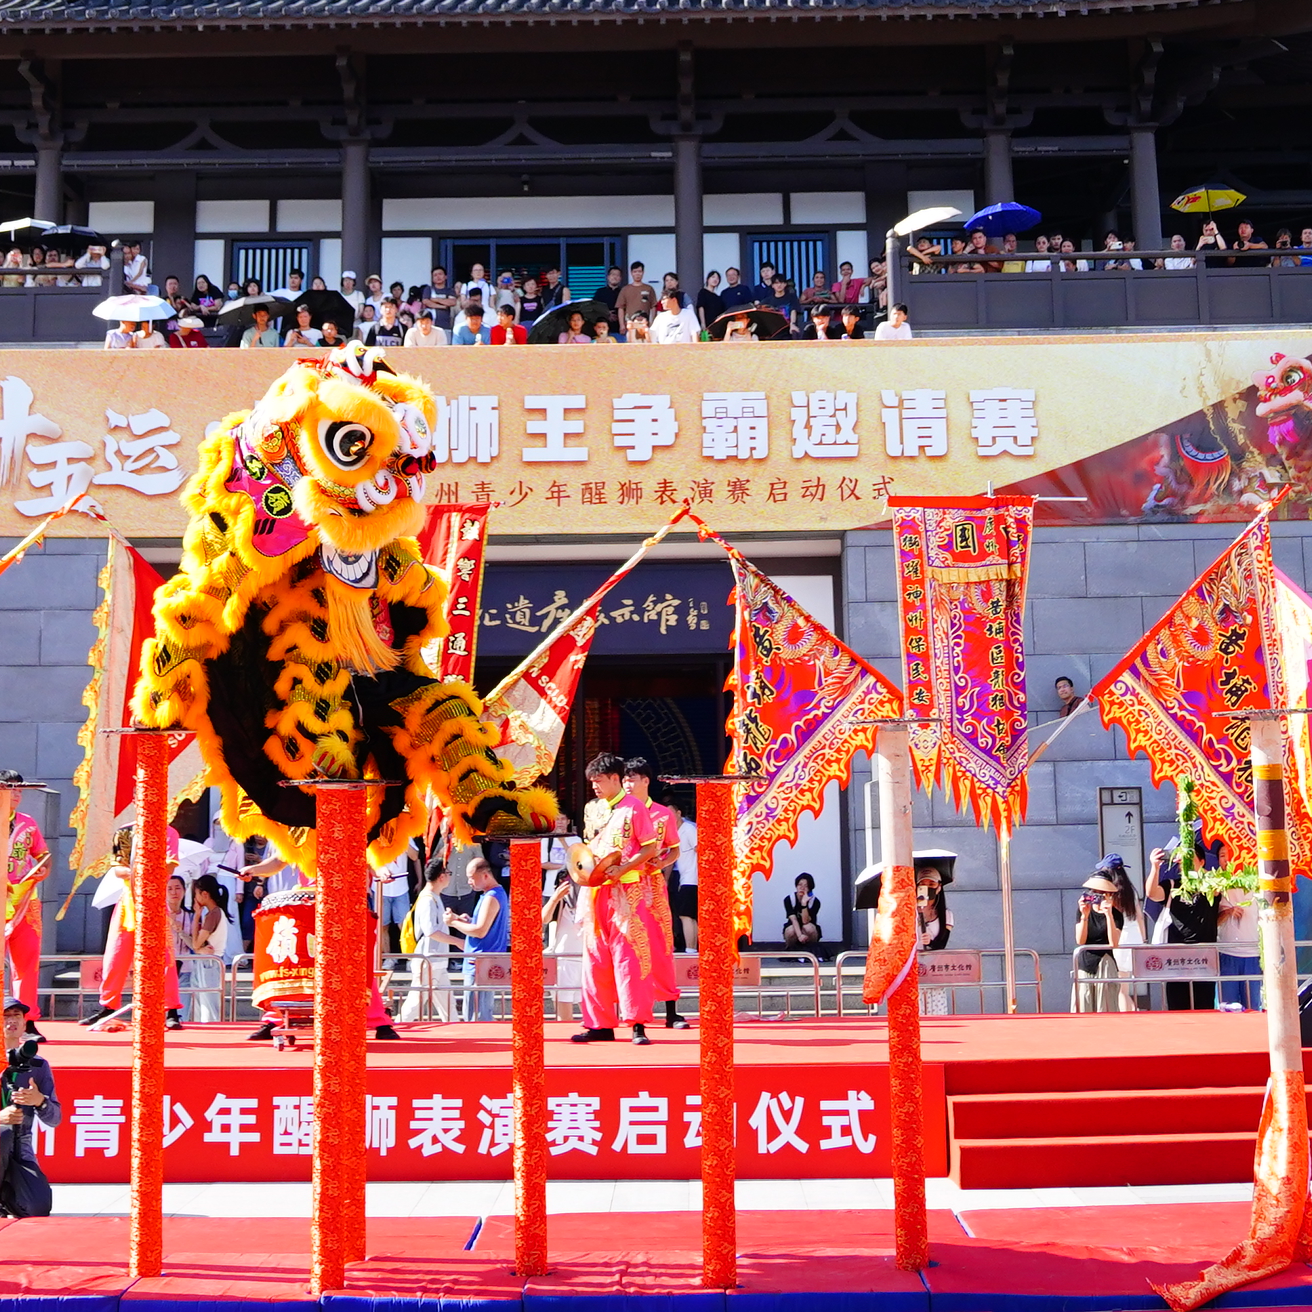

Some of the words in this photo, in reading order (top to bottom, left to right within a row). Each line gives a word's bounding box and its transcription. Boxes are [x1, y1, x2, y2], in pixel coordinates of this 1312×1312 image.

[434, 387, 1040, 464] 狮王争霸邀请赛
